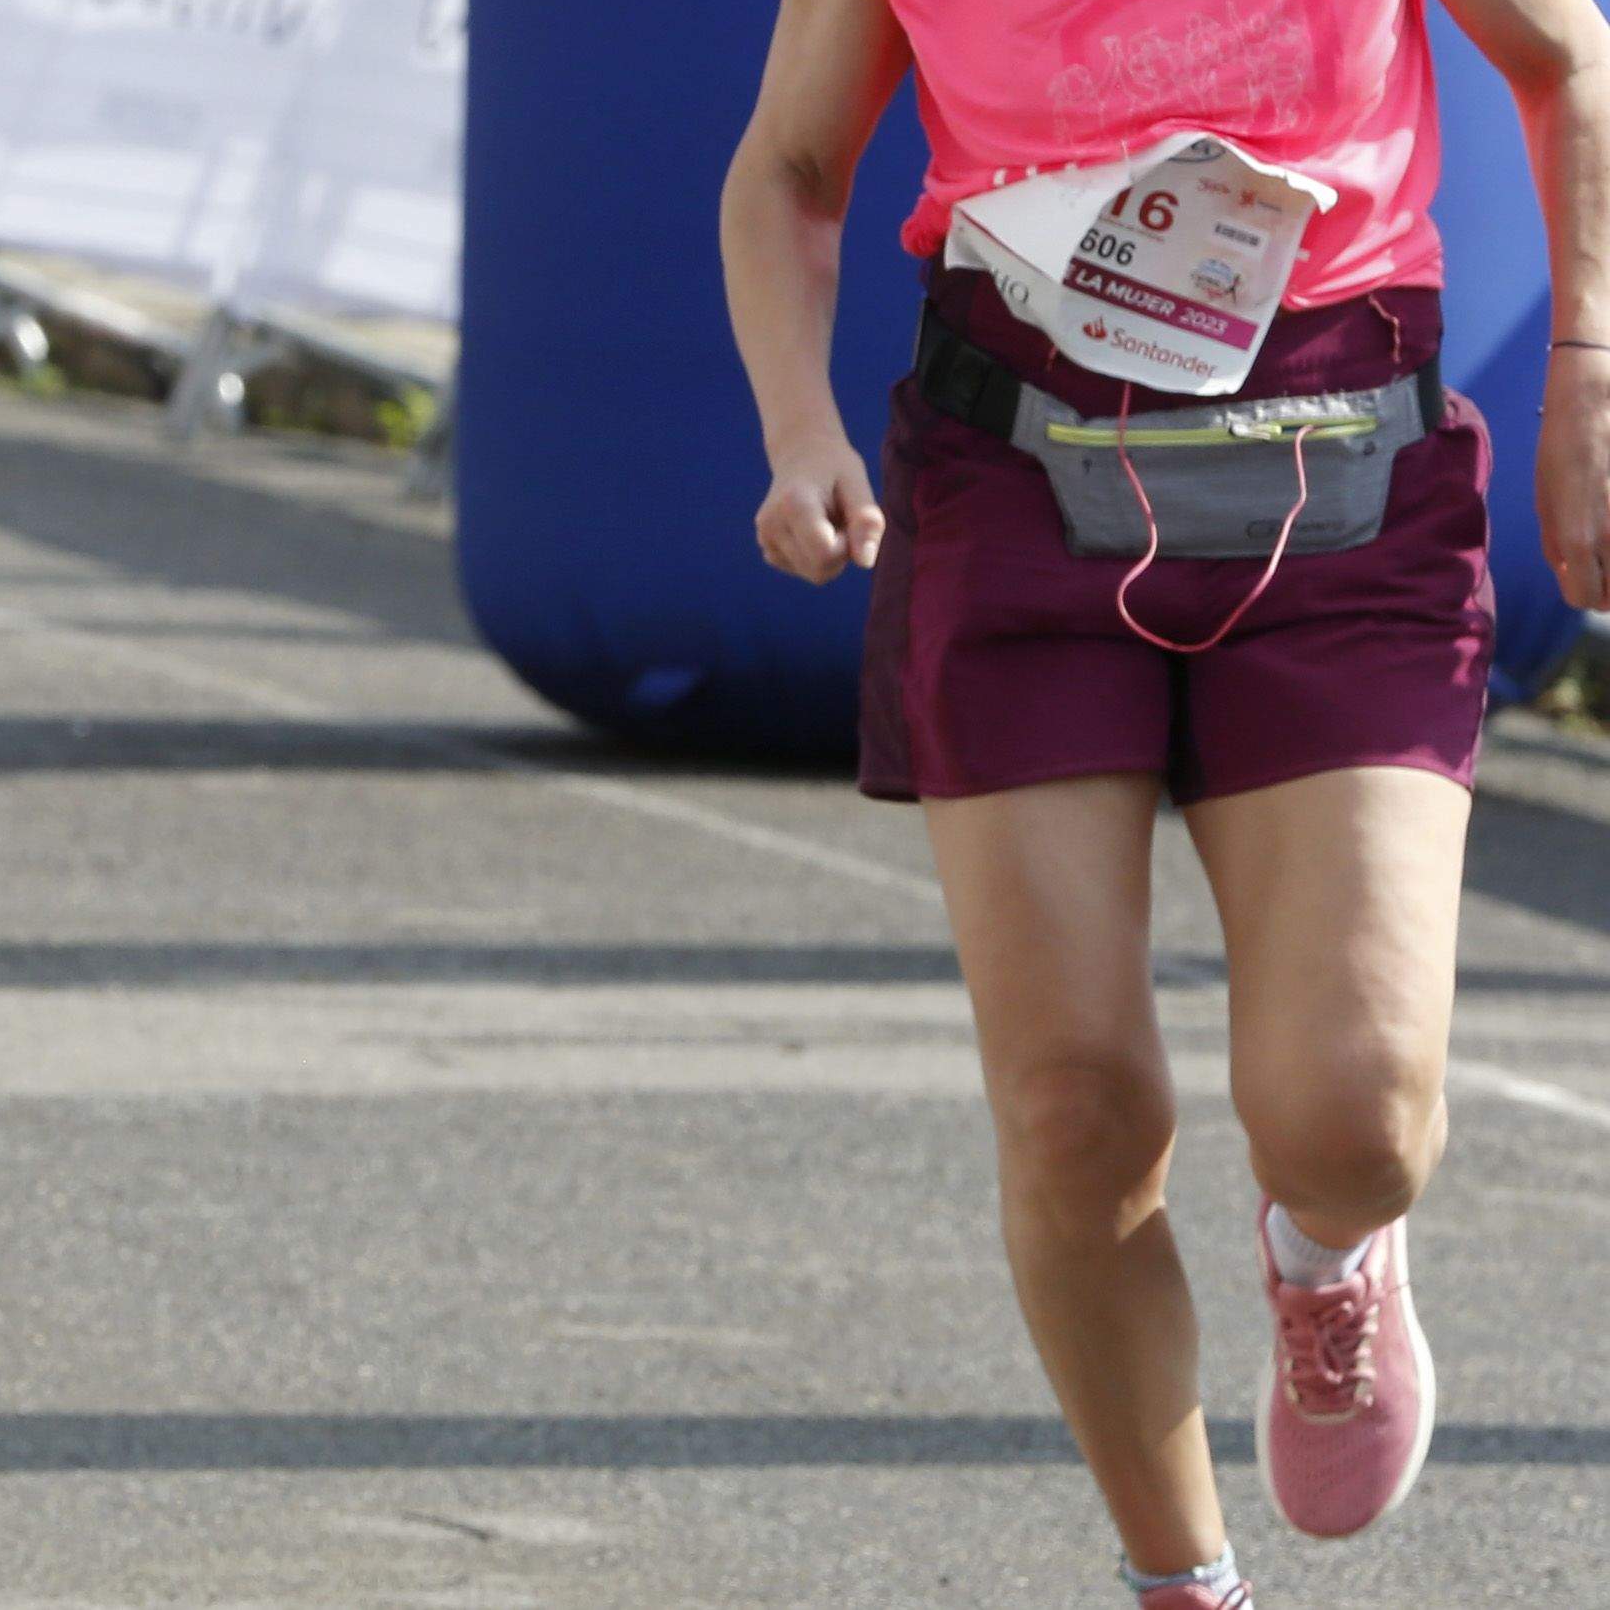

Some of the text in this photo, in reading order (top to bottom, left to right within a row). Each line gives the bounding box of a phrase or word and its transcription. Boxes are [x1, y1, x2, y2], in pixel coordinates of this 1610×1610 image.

[1075, 268, 1103, 293] LA
[1105, 280, 1177, 318] MUJER
[1179, 307, 1229, 336] 2023
[1110, 326, 1219, 379] Santander
